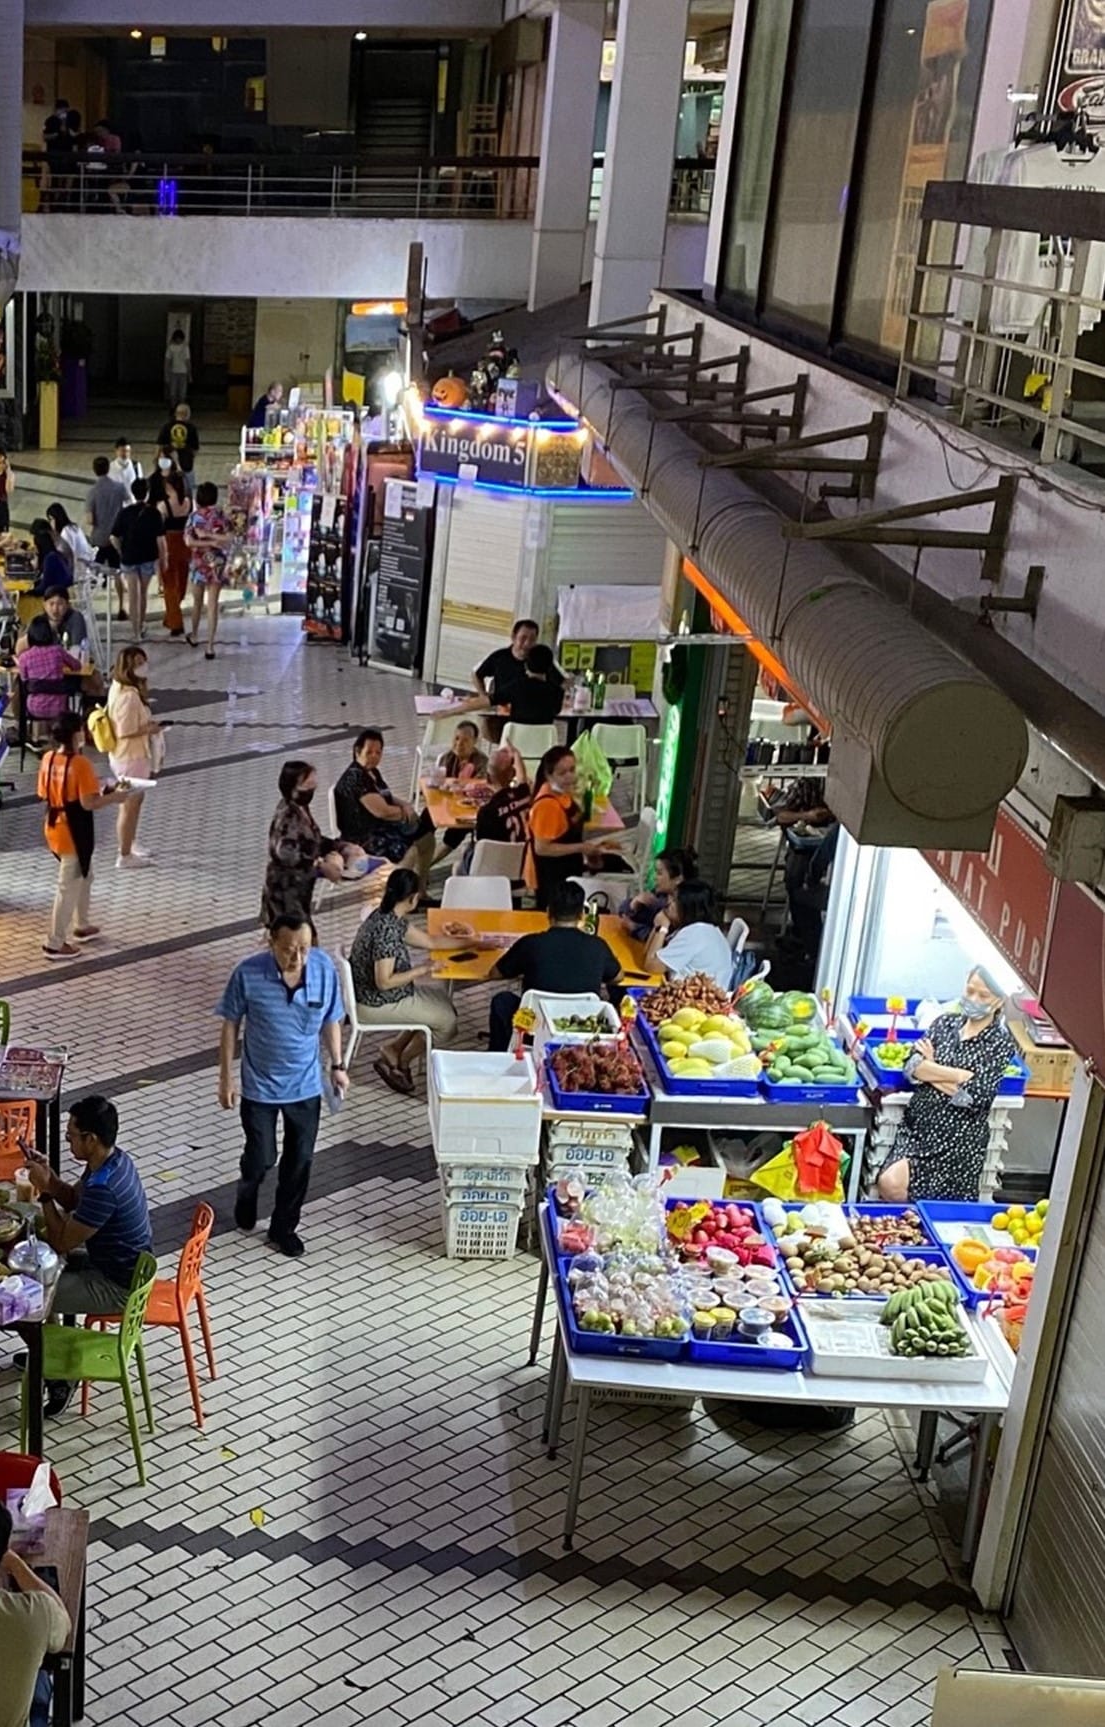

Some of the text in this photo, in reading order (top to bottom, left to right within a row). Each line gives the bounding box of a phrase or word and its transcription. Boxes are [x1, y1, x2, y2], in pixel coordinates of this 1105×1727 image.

[424, 430, 526, 465] Kingdom 5
[998, 901, 1042, 976] PUB
